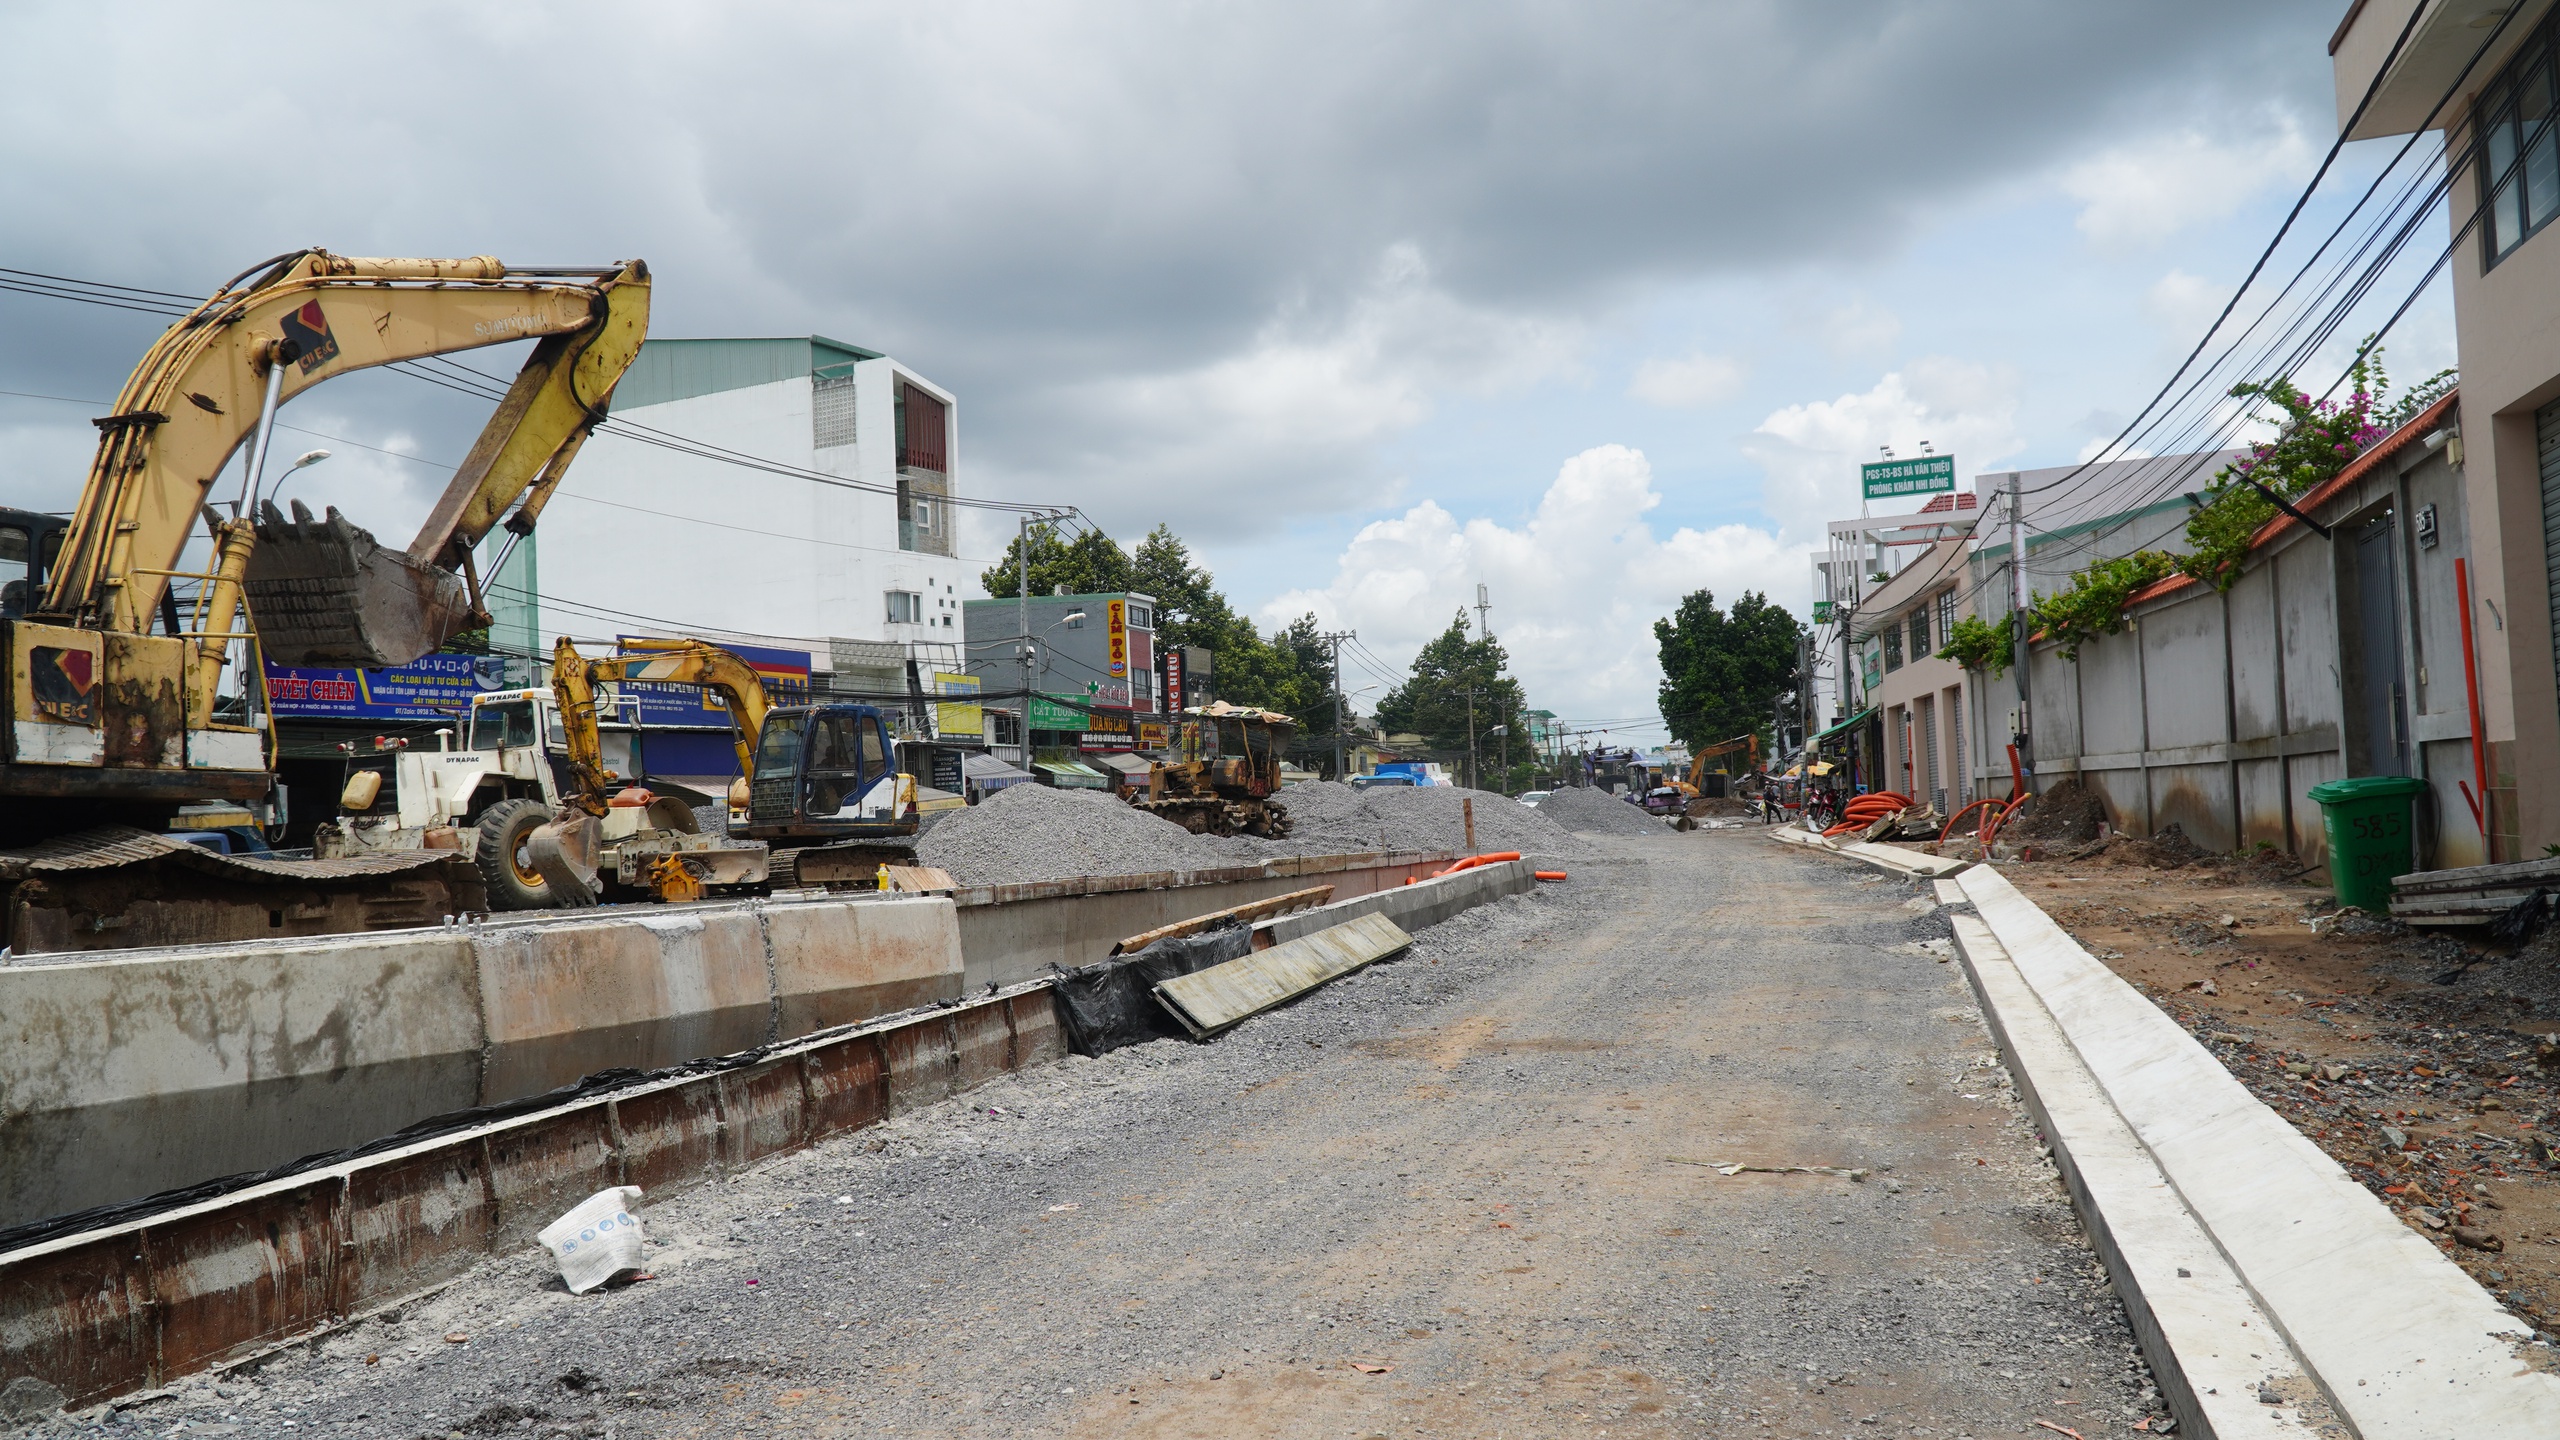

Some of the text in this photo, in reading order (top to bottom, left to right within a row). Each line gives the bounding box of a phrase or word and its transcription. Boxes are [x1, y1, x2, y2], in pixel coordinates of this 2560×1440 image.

[474, 313, 547, 337] SUMITOMO
[1866, 460, 1950, 480] PGS-TS-BS HÀ VĂN THIỆU
[1869, 475, 1949, 495] PHÒNG KHÁM NHI ĐỒNG
[390, 674, 405, 683] CÁC
[406, 676, 421, 686] LOẠI
[422, 676, 435, 686] VẬT
[1167, 656, 1180, 686] HIỆU
[311, 672, 356, 702] CHIẾN
[486, 693, 521, 702] DYNAPAC
[602, 757, 619, 765] Castrol
[2353, 812, 2401, 840] 585
